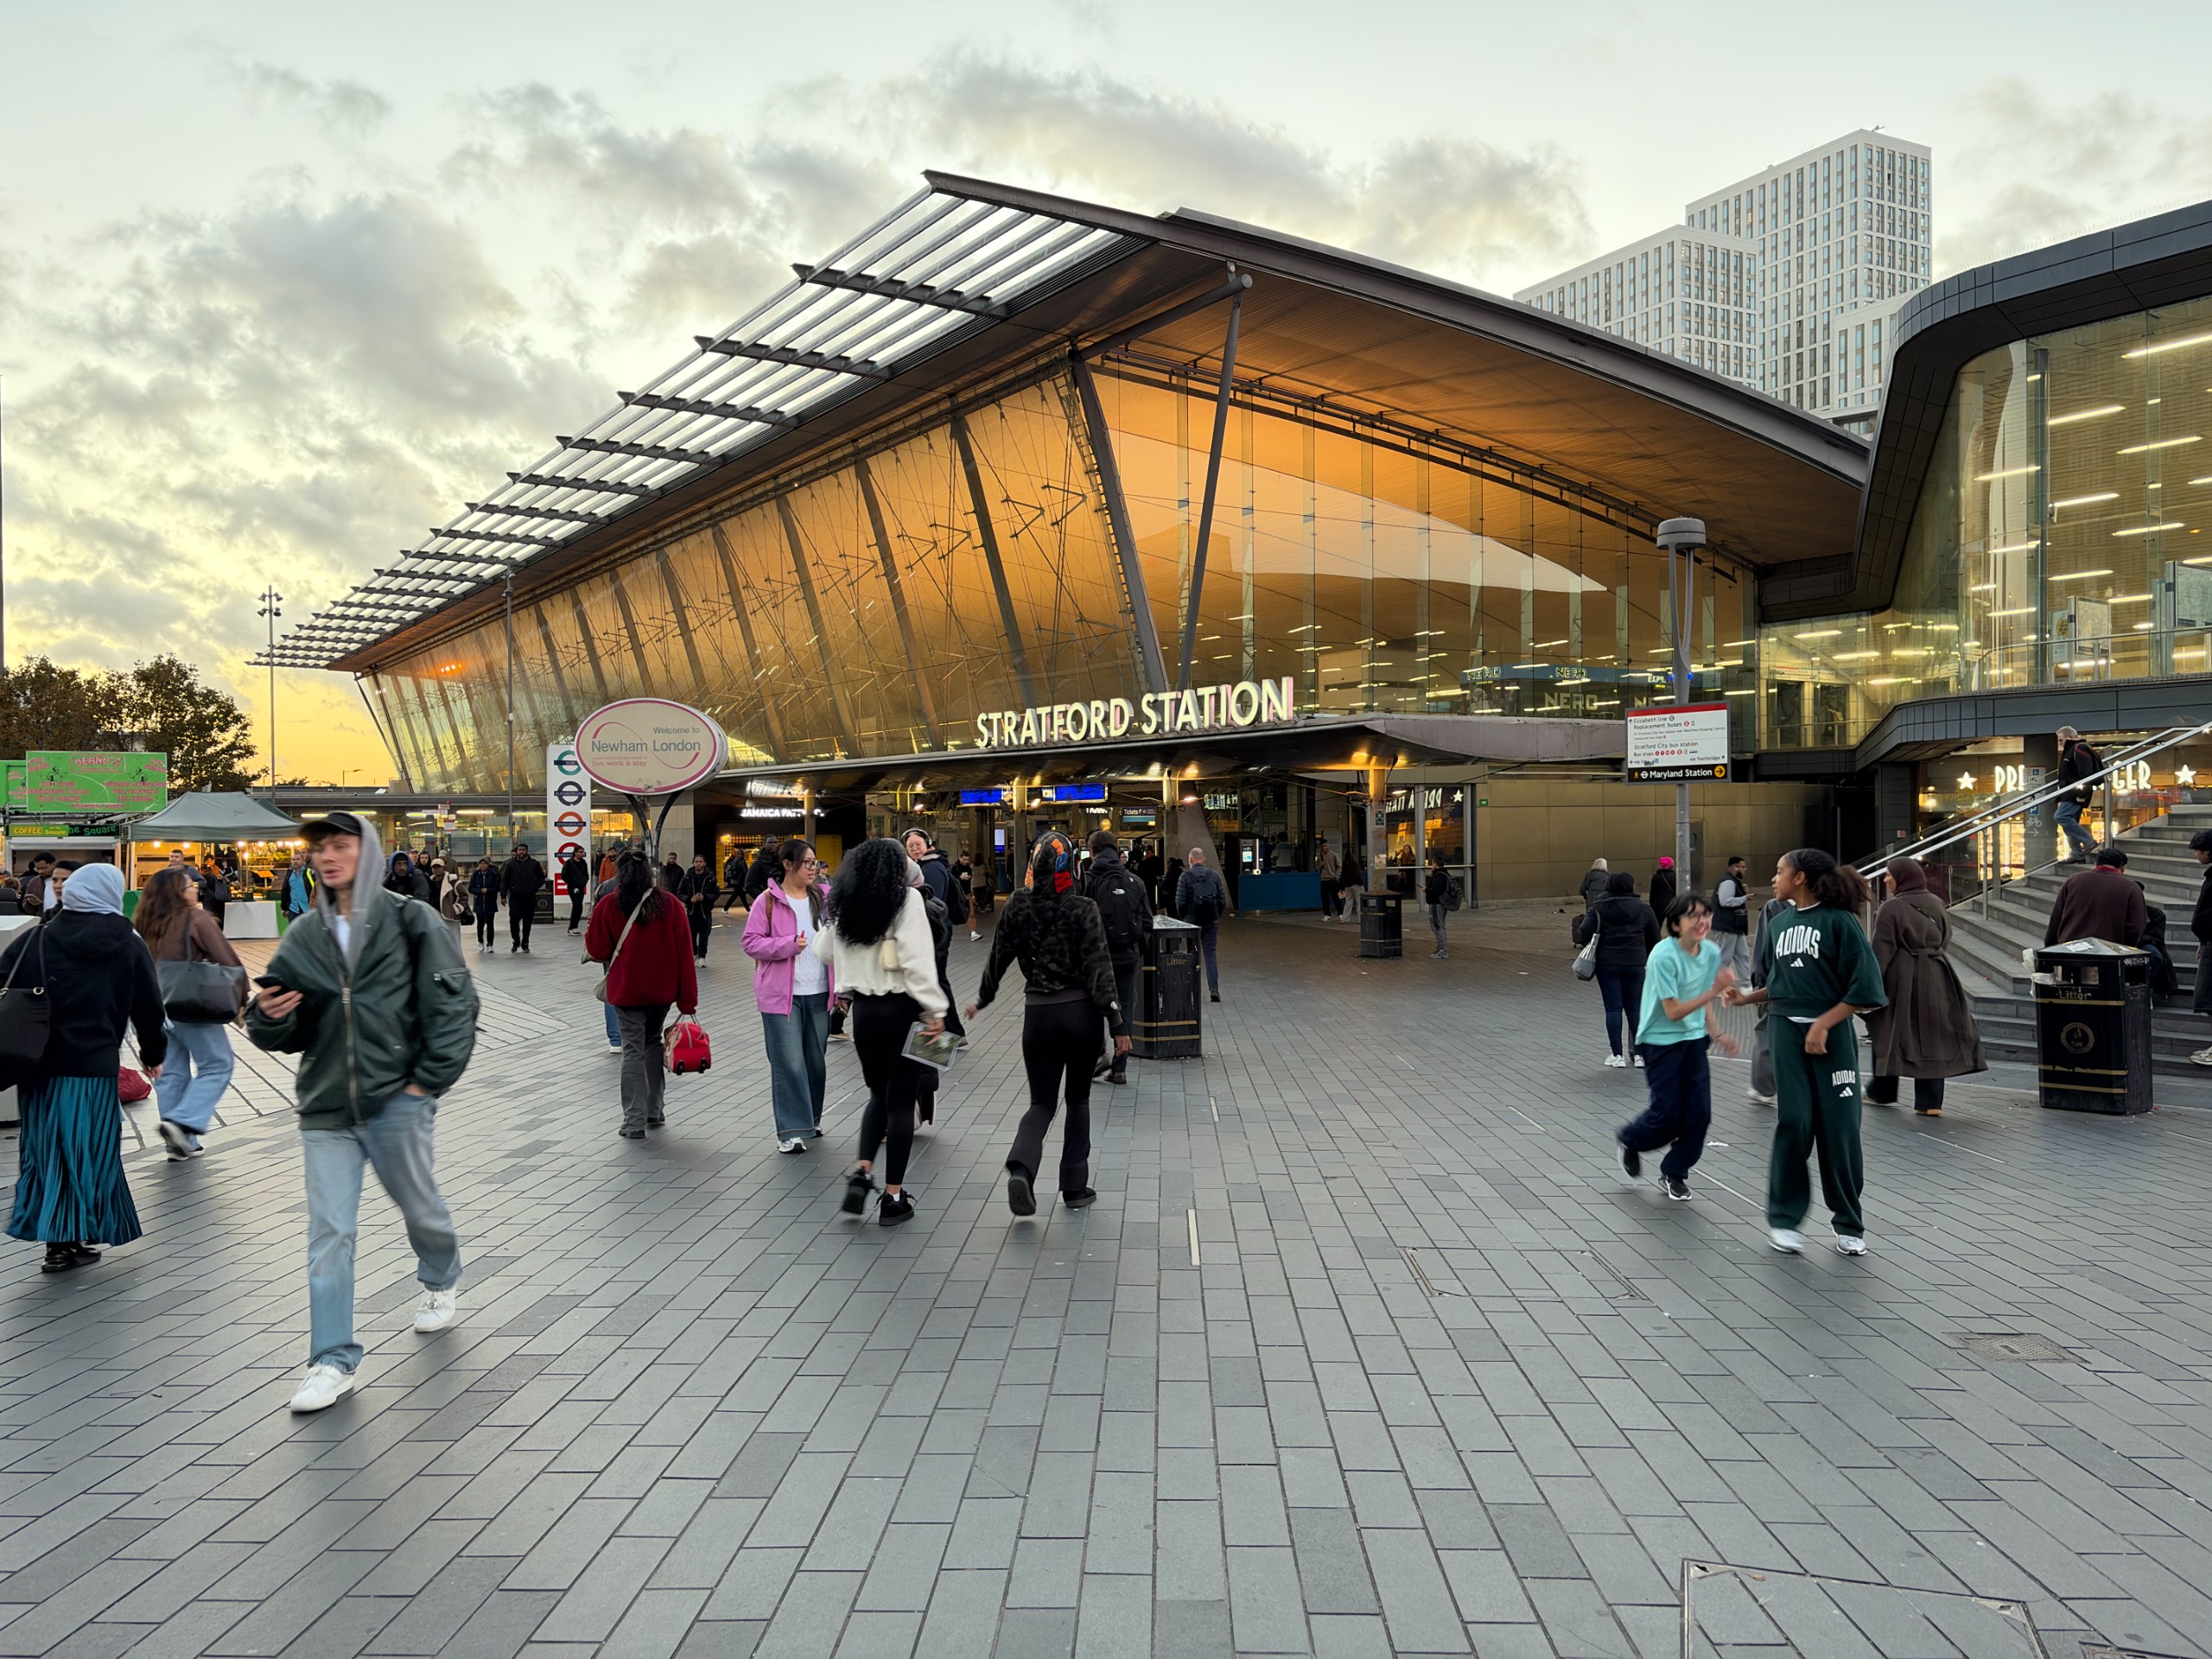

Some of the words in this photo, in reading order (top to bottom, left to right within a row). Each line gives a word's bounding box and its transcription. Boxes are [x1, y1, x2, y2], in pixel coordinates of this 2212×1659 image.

[1467, 667, 1501, 681] NERO
[1556, 667, 1587, 678] NERO
[1545, 692, 1599, 710] NERO
[976, 697, 1135, 748] STRATFORD
[1141, 676, 1294, 734] STATION
[592, 740, 648, 752] Newham
[653, 739, 701, 751] London
[1649, 770, 1683, 779] Maryland
[741, 809, 779, 817] JAMAICA
[84, 825, 117, 836] Square
[1776, 925, 1821, 959] ADIDAS
[2059, 990, 2088, 1000] Litter
[1832, 1070, 1855, 1086] ADIDAS
